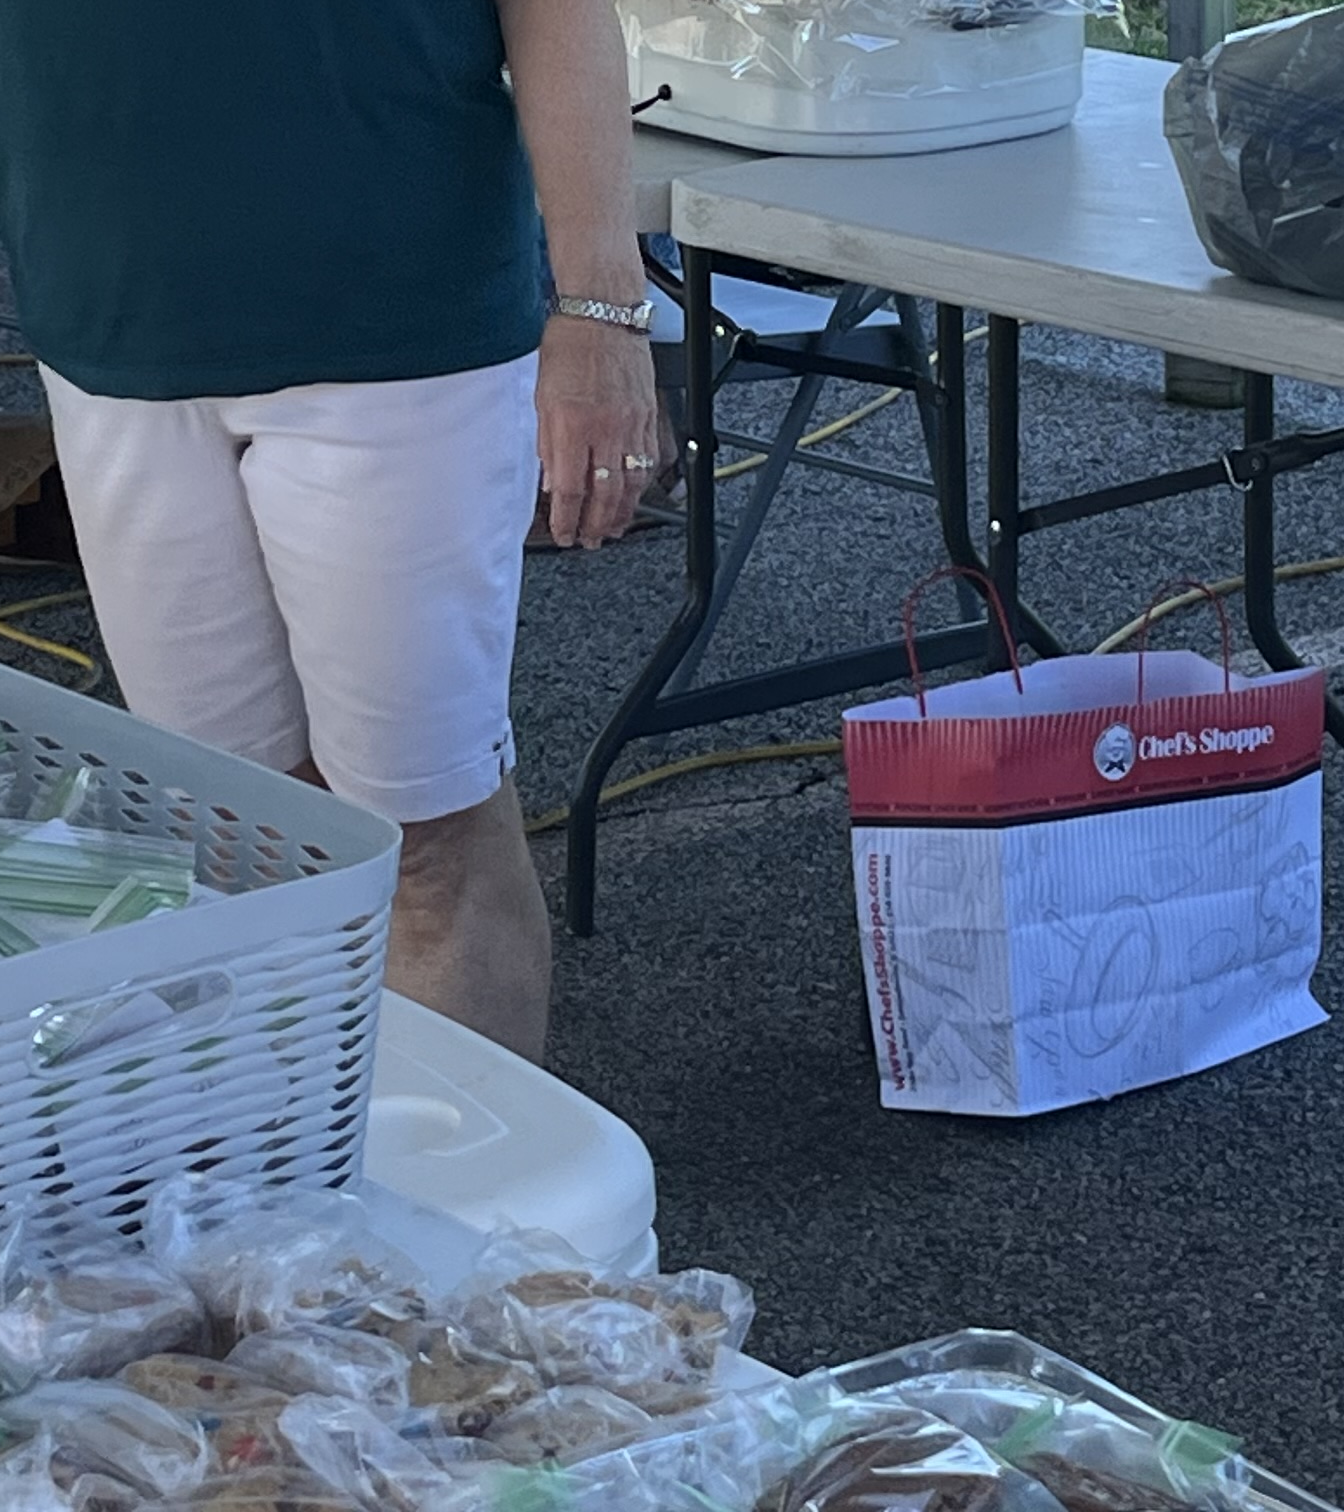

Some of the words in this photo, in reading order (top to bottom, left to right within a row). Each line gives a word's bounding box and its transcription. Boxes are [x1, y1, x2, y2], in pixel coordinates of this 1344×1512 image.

[1138, 731, 1197, 761] Chef's
[1199, 724, 1275, 754] Shoppe
[866, 852, 905, 1092] www.ChefsShoppe.com
